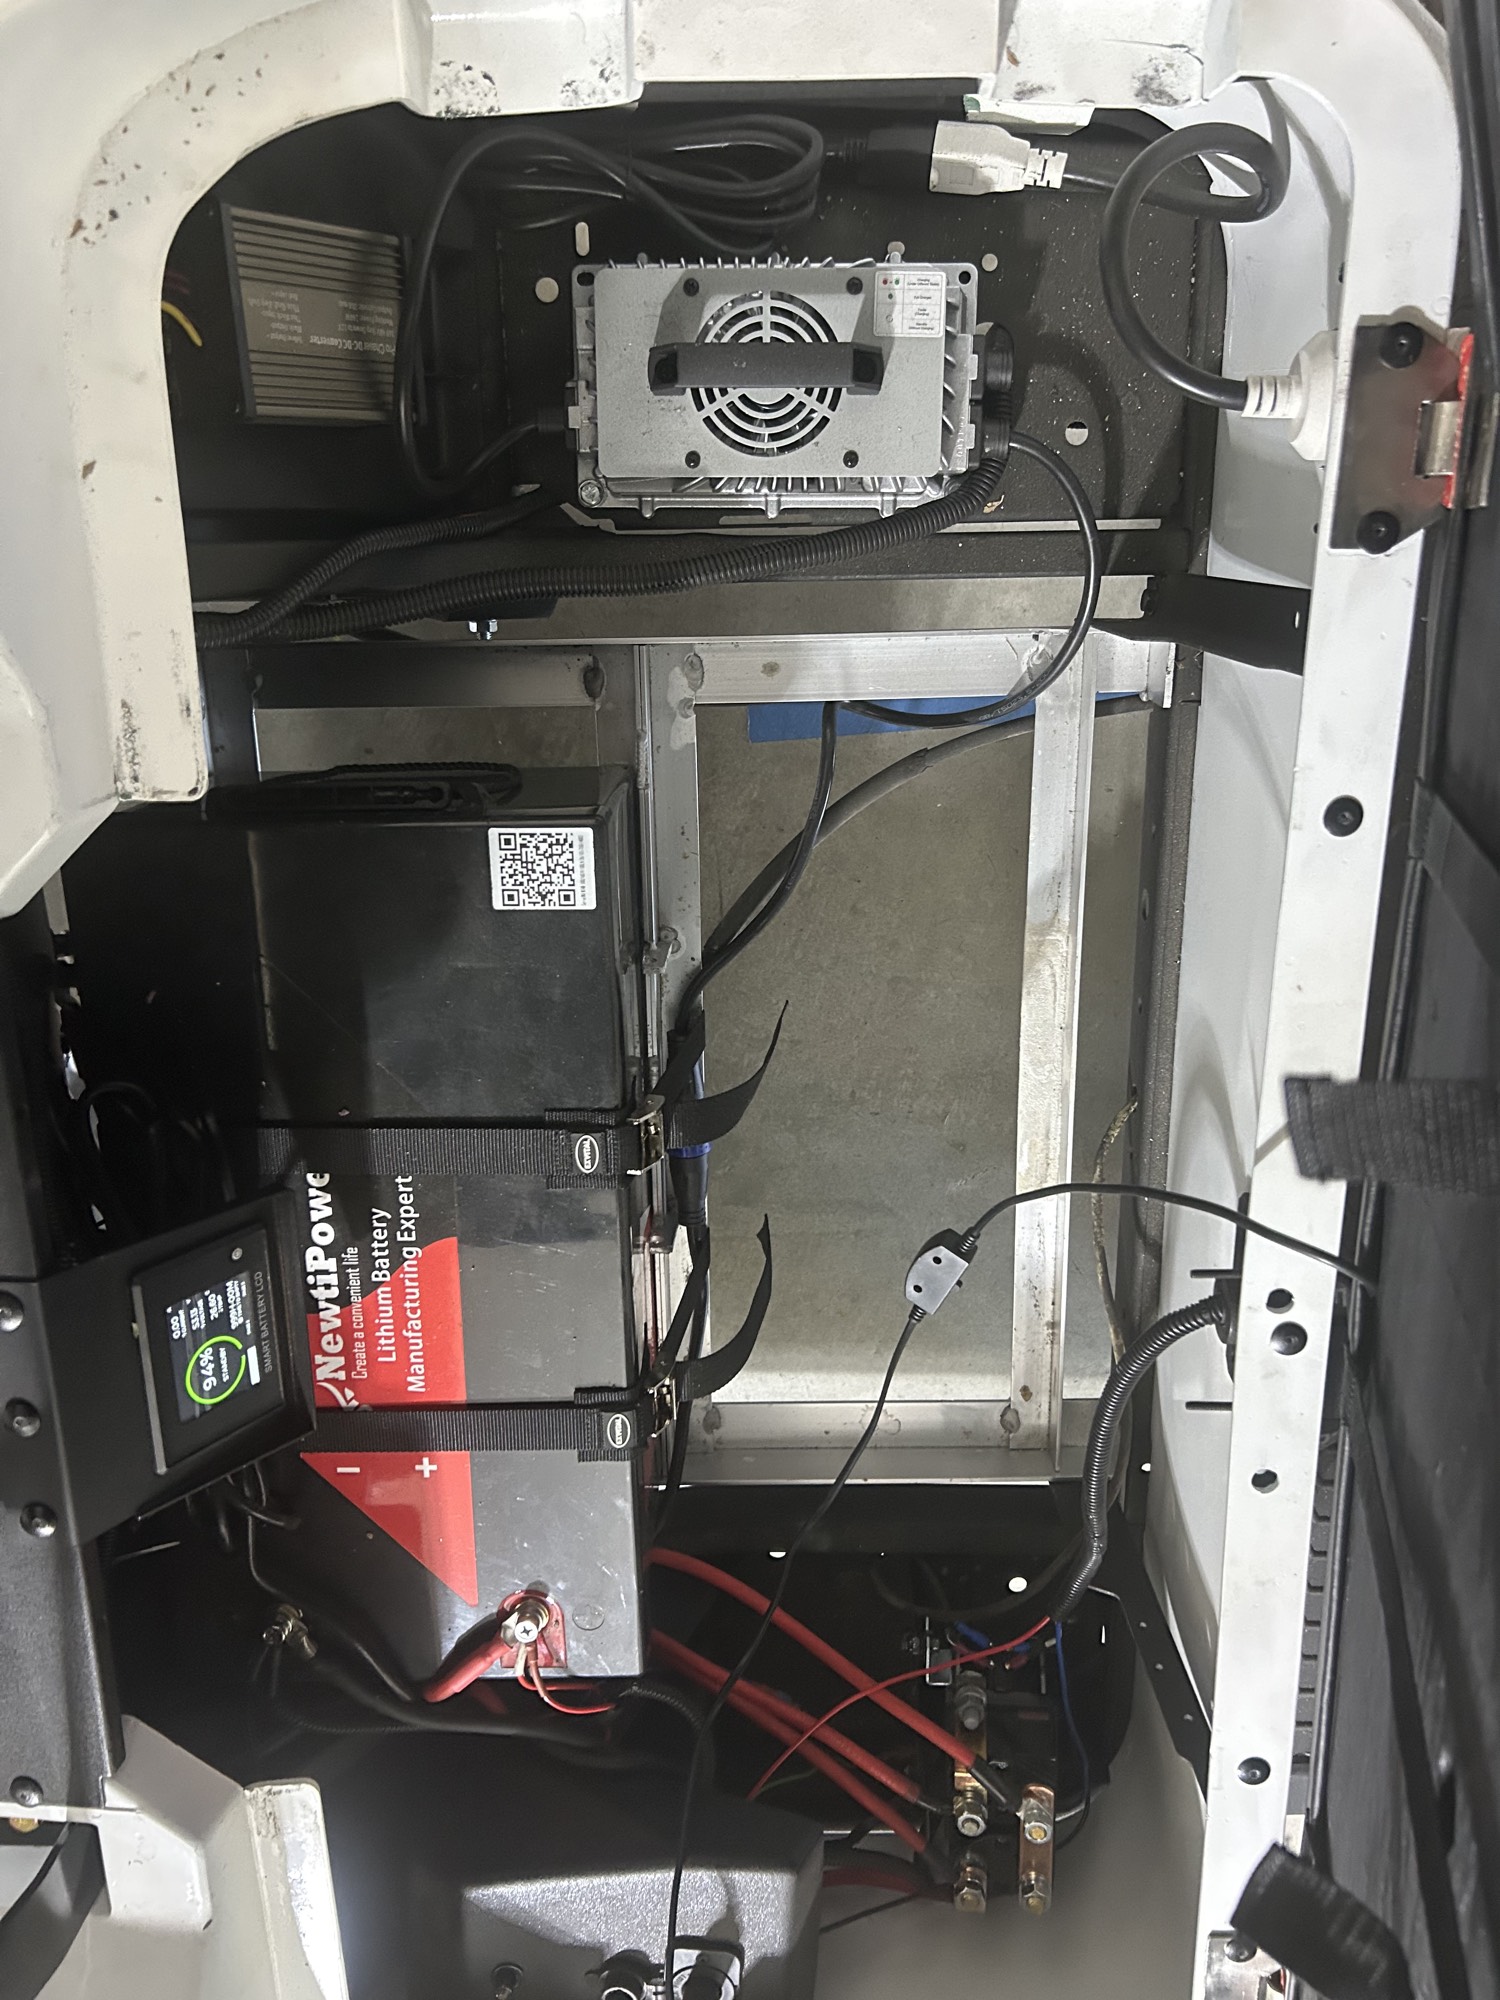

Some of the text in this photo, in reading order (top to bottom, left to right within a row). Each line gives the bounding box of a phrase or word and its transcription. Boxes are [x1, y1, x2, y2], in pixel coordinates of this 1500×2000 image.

[309, 336, 342, 349] Converter
[342, 1246, 360, 1265] life
[304, 1172, 347, 1381] NewtiPowe
[370, 1208, 397, 1362] Lithium Battery
[394, 1175, 426, 1392] Manufacturing Expert
[209, 1294, 219, 1320] 26.60
[347, 1268, 364, 1329] convenient
[170, 1315, 181, 1339] 0.00
[255, 1271, 273, 1373] SMART BATTERY LCD
[199, 1347, 217, 1392] 94%
[219, 1347, 229, 1382] STANDBY
[351, 1342, 368, 1379] Create
